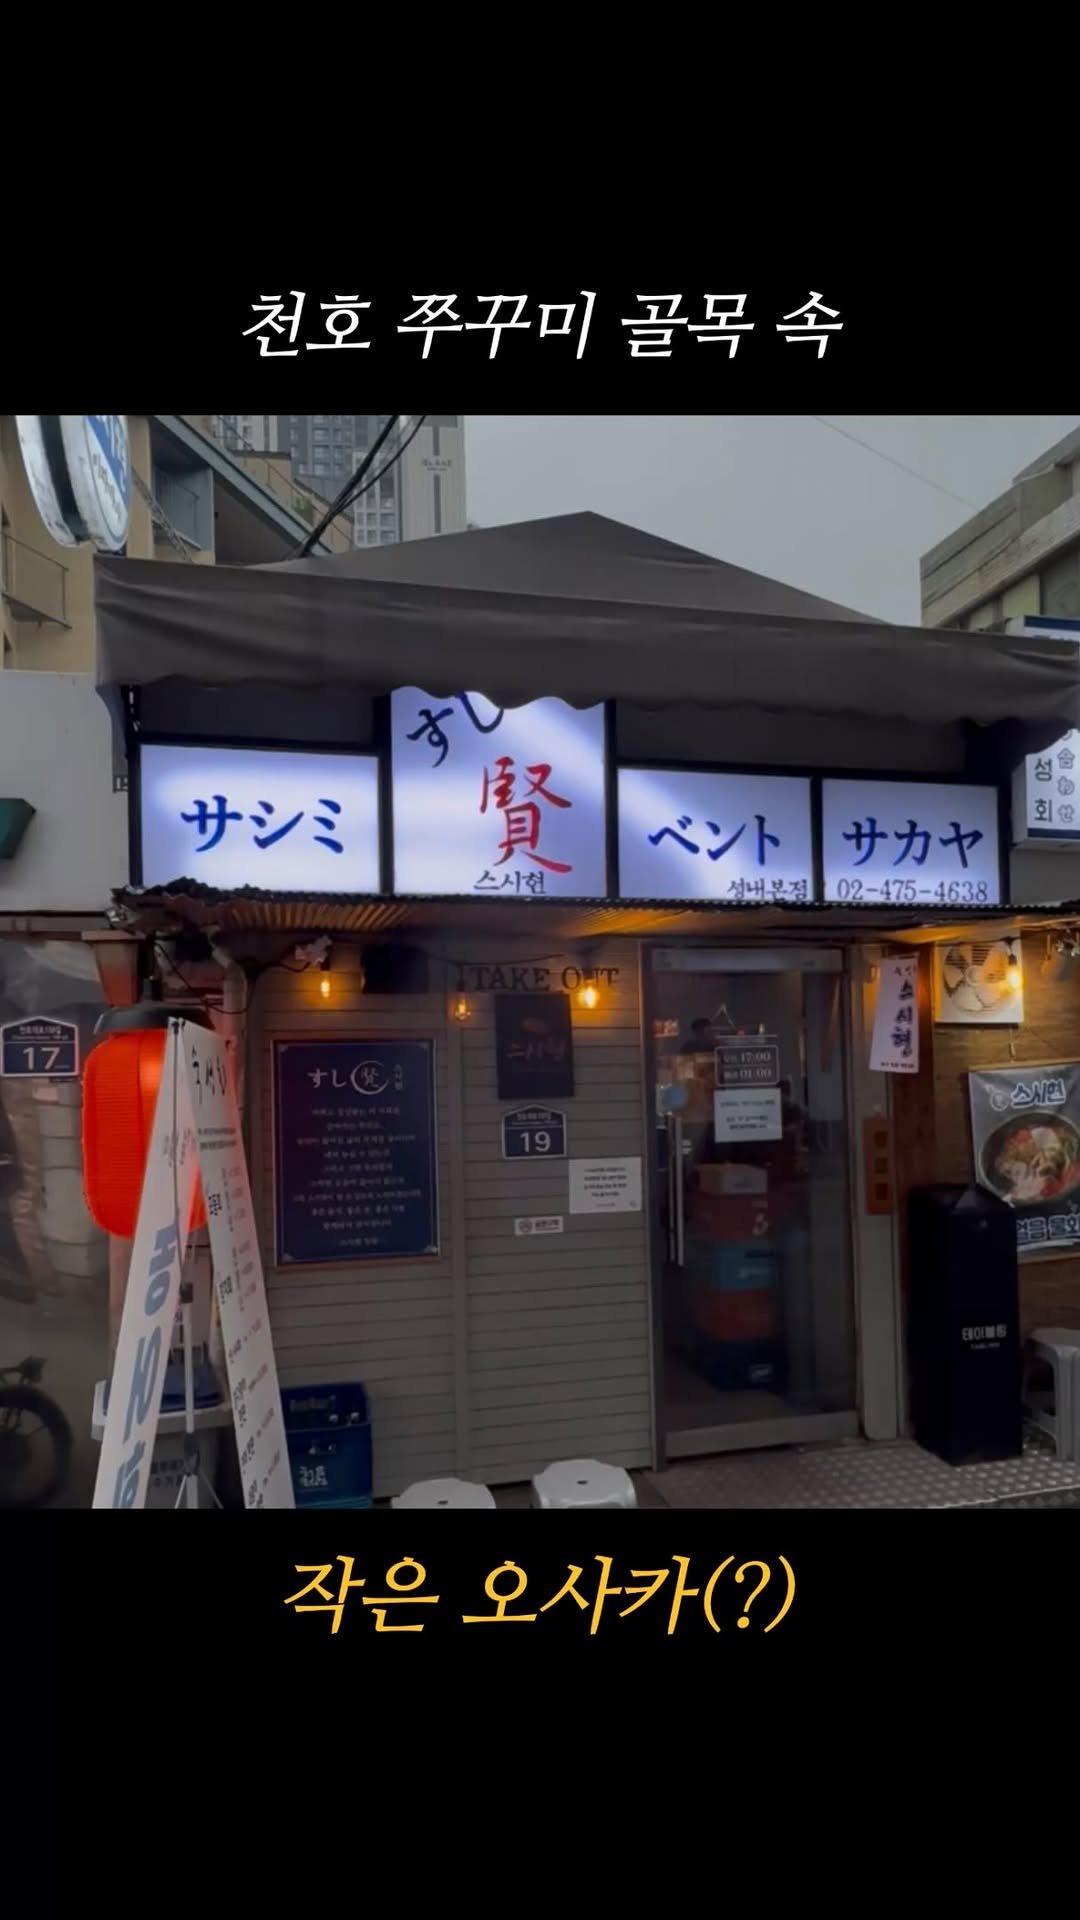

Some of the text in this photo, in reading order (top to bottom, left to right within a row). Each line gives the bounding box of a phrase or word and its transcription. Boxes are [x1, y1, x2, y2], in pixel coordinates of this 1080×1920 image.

[180, 795, 344, 854] サシミ
[480, 756, 573, 874] 賢
[648, 815, 781, 866] ベント
[842, 816, 984, 868] サカヤ
[473, 870, 546, 894] 스시현
[727, 878, 808, 901] 성내본점
[837, 878, 988, 902] 02-475-4638
[469, 966, 550, 992] TAKE
[22, 1046, 61, 1071] 17
[307, 1068, 348, 1088] すし
[519, 1130, 551, 1153] 19
